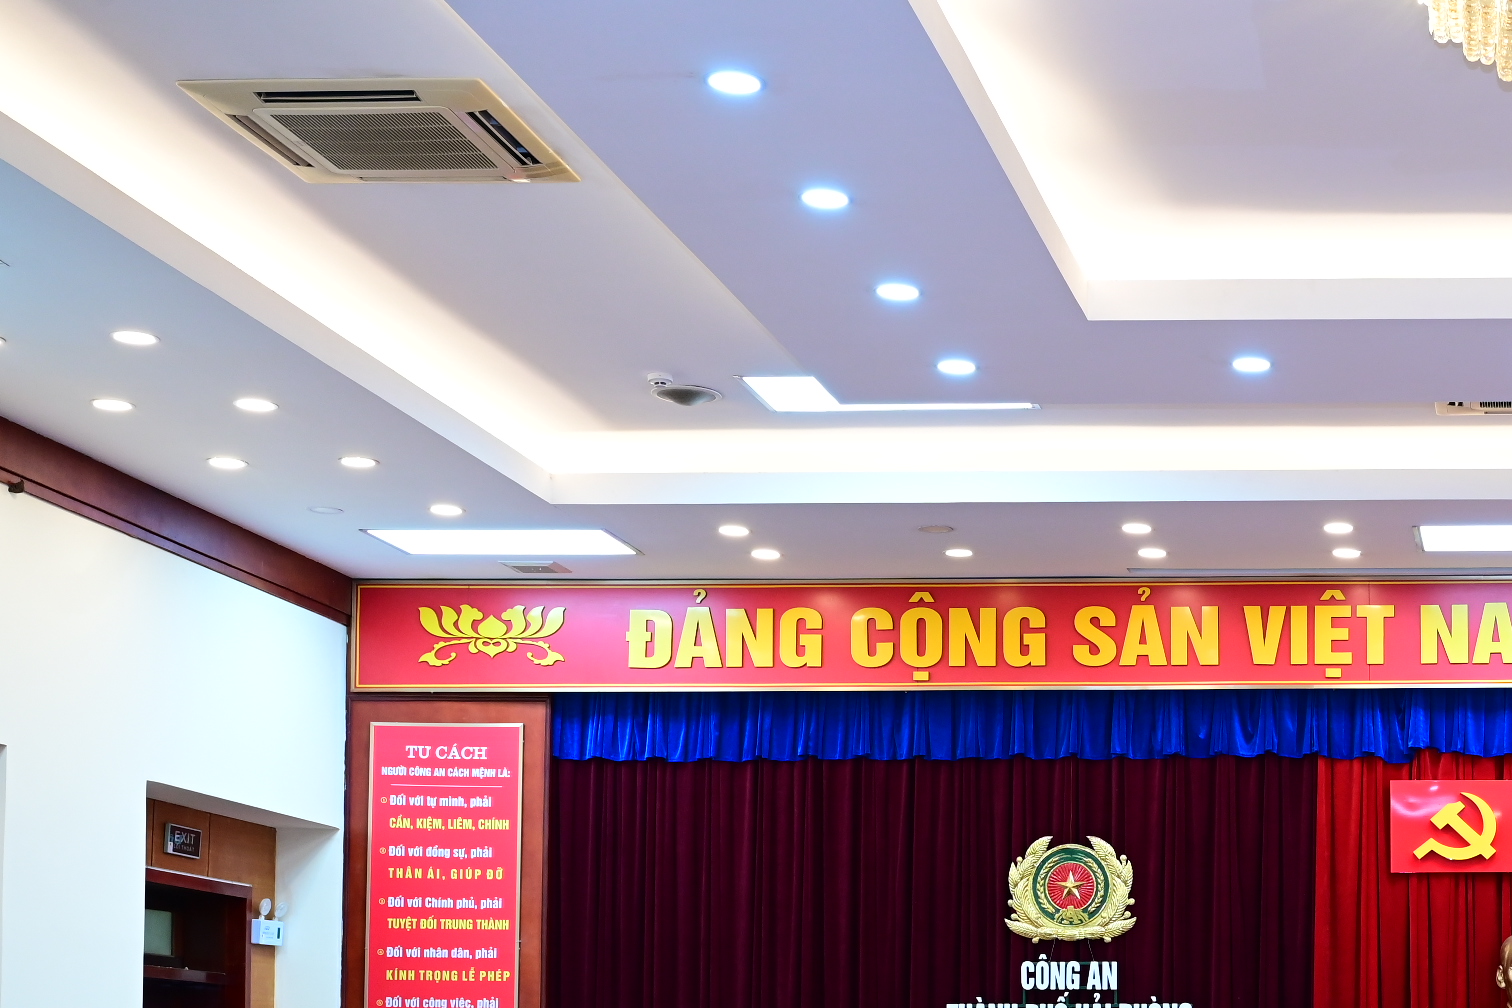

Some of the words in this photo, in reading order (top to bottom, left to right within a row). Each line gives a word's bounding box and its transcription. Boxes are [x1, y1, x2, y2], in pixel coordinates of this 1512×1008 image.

[626, 589, 823, 668] ĐẢNG
[851, 592, 1046, 680] CỘNG
[1073, 587, 1219, 666] SẢN
[1243, 590, 1395, 677] VIỆT
[436, 743, 487, 759] CÁCH
[382, 765, 407, 775] NGƯỜI
[409, 766, 431, 776] CÔNG
[434, 768, 445, 776] AN
[448, 767, 469, 777] CÁCH
[498, 767, 510, 777] LÀ:
[174, 830, 196, 845] EXIT
[389, 844, 405, 856] Đối
[408, 846, 423, 856] với
[426, 845, 450, 858] đồng
[471, 846, 492, 858] phải
[389, 866, 422, 878] THÂN
[427, 867, 445, 880] ÁI,
[451, 867, 481, 879] GIÚP
[388, 895, 404, 907] Đối
[407, 897, 422, 907] với
[456, 897, 477, 909] phủ,
[481, 897, 502, 909] phải
[387, 916, 417, 931] TUYỆT
[420, 915, 437, 929] ĐỐI
[440, 919, 473, 929] TRUNG
[476, 917, 509, 930] THÀNH
[386, 968, 415, 980] KÍNH
[419, 970, 458, 983] TRỌNG
[480, 969, 510, 981] PHÉP
[1020, 954, 1080, 990] CÔNG
[1086, 960, 1118, 990] AN
